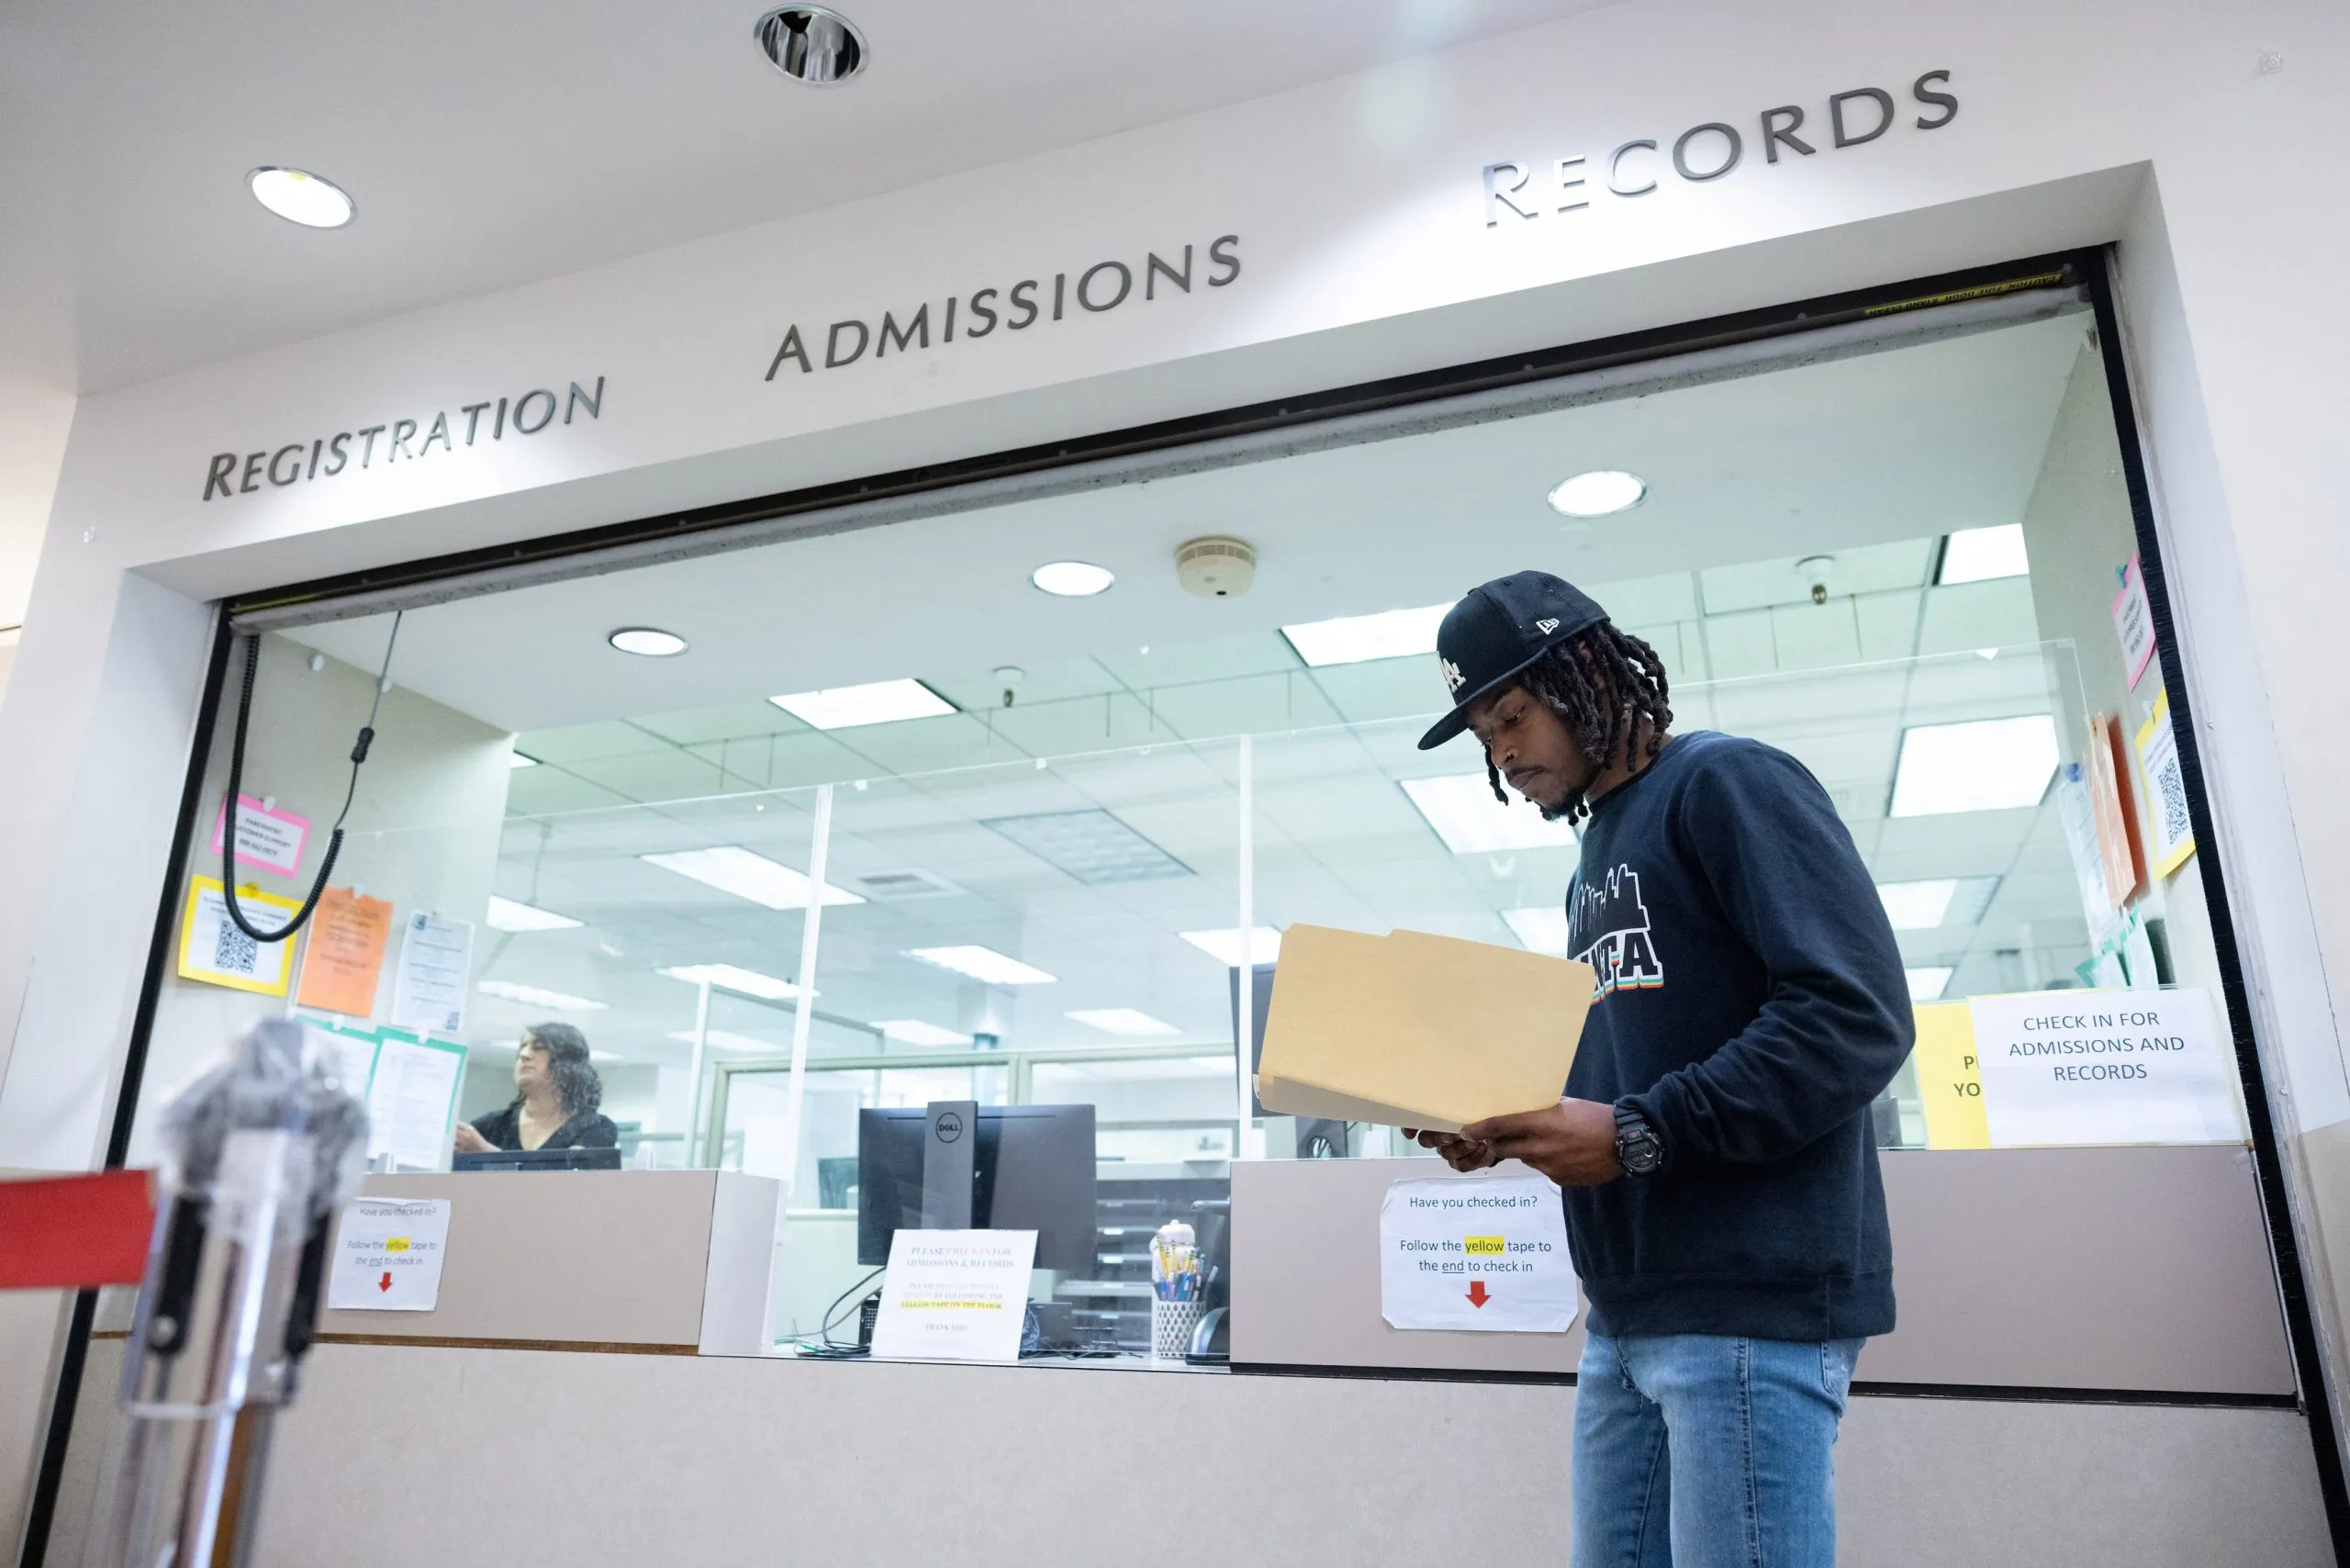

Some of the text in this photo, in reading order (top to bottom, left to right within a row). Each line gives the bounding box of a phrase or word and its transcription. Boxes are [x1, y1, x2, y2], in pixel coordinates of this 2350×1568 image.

[1483, 69, 1958, 228] RECORDS
[765, 234, 1241, 381] ADMISSIONS
[202, 375, 605, 501] REGISTRATION
[2023, 1012, 2160, 1031] CHECK IN FOR
[2009, 1036, 2185, 1057] ADMISSIONS AND
[1964, 1056, 1979, 1070] P
[2053, 1063, 2147, 1081] RECORDS
[1409, 1196, 1538, 1209] Have you checked in?
[360, 1206, 437, 1217] Have you checked in?
[347, 1240, 372, 1249] Follow
[372, 1241, 385, 1249] the
[386, 1241, 409, 1251] yellow
[410, 1242, 428, 1251] tape
[912, 1248, 946, 1256] PLEASE
[1400, 1239, 1551, 1254] Follow the yellow tape to
[354, 1257, 423, 1266] the end to check in
[907, 1259, 959, 1267] ADMISSIONS
[970, 1260, 1014, 1268] RECORDS
[1419, 1260, 1533, 1273] the end to check in
